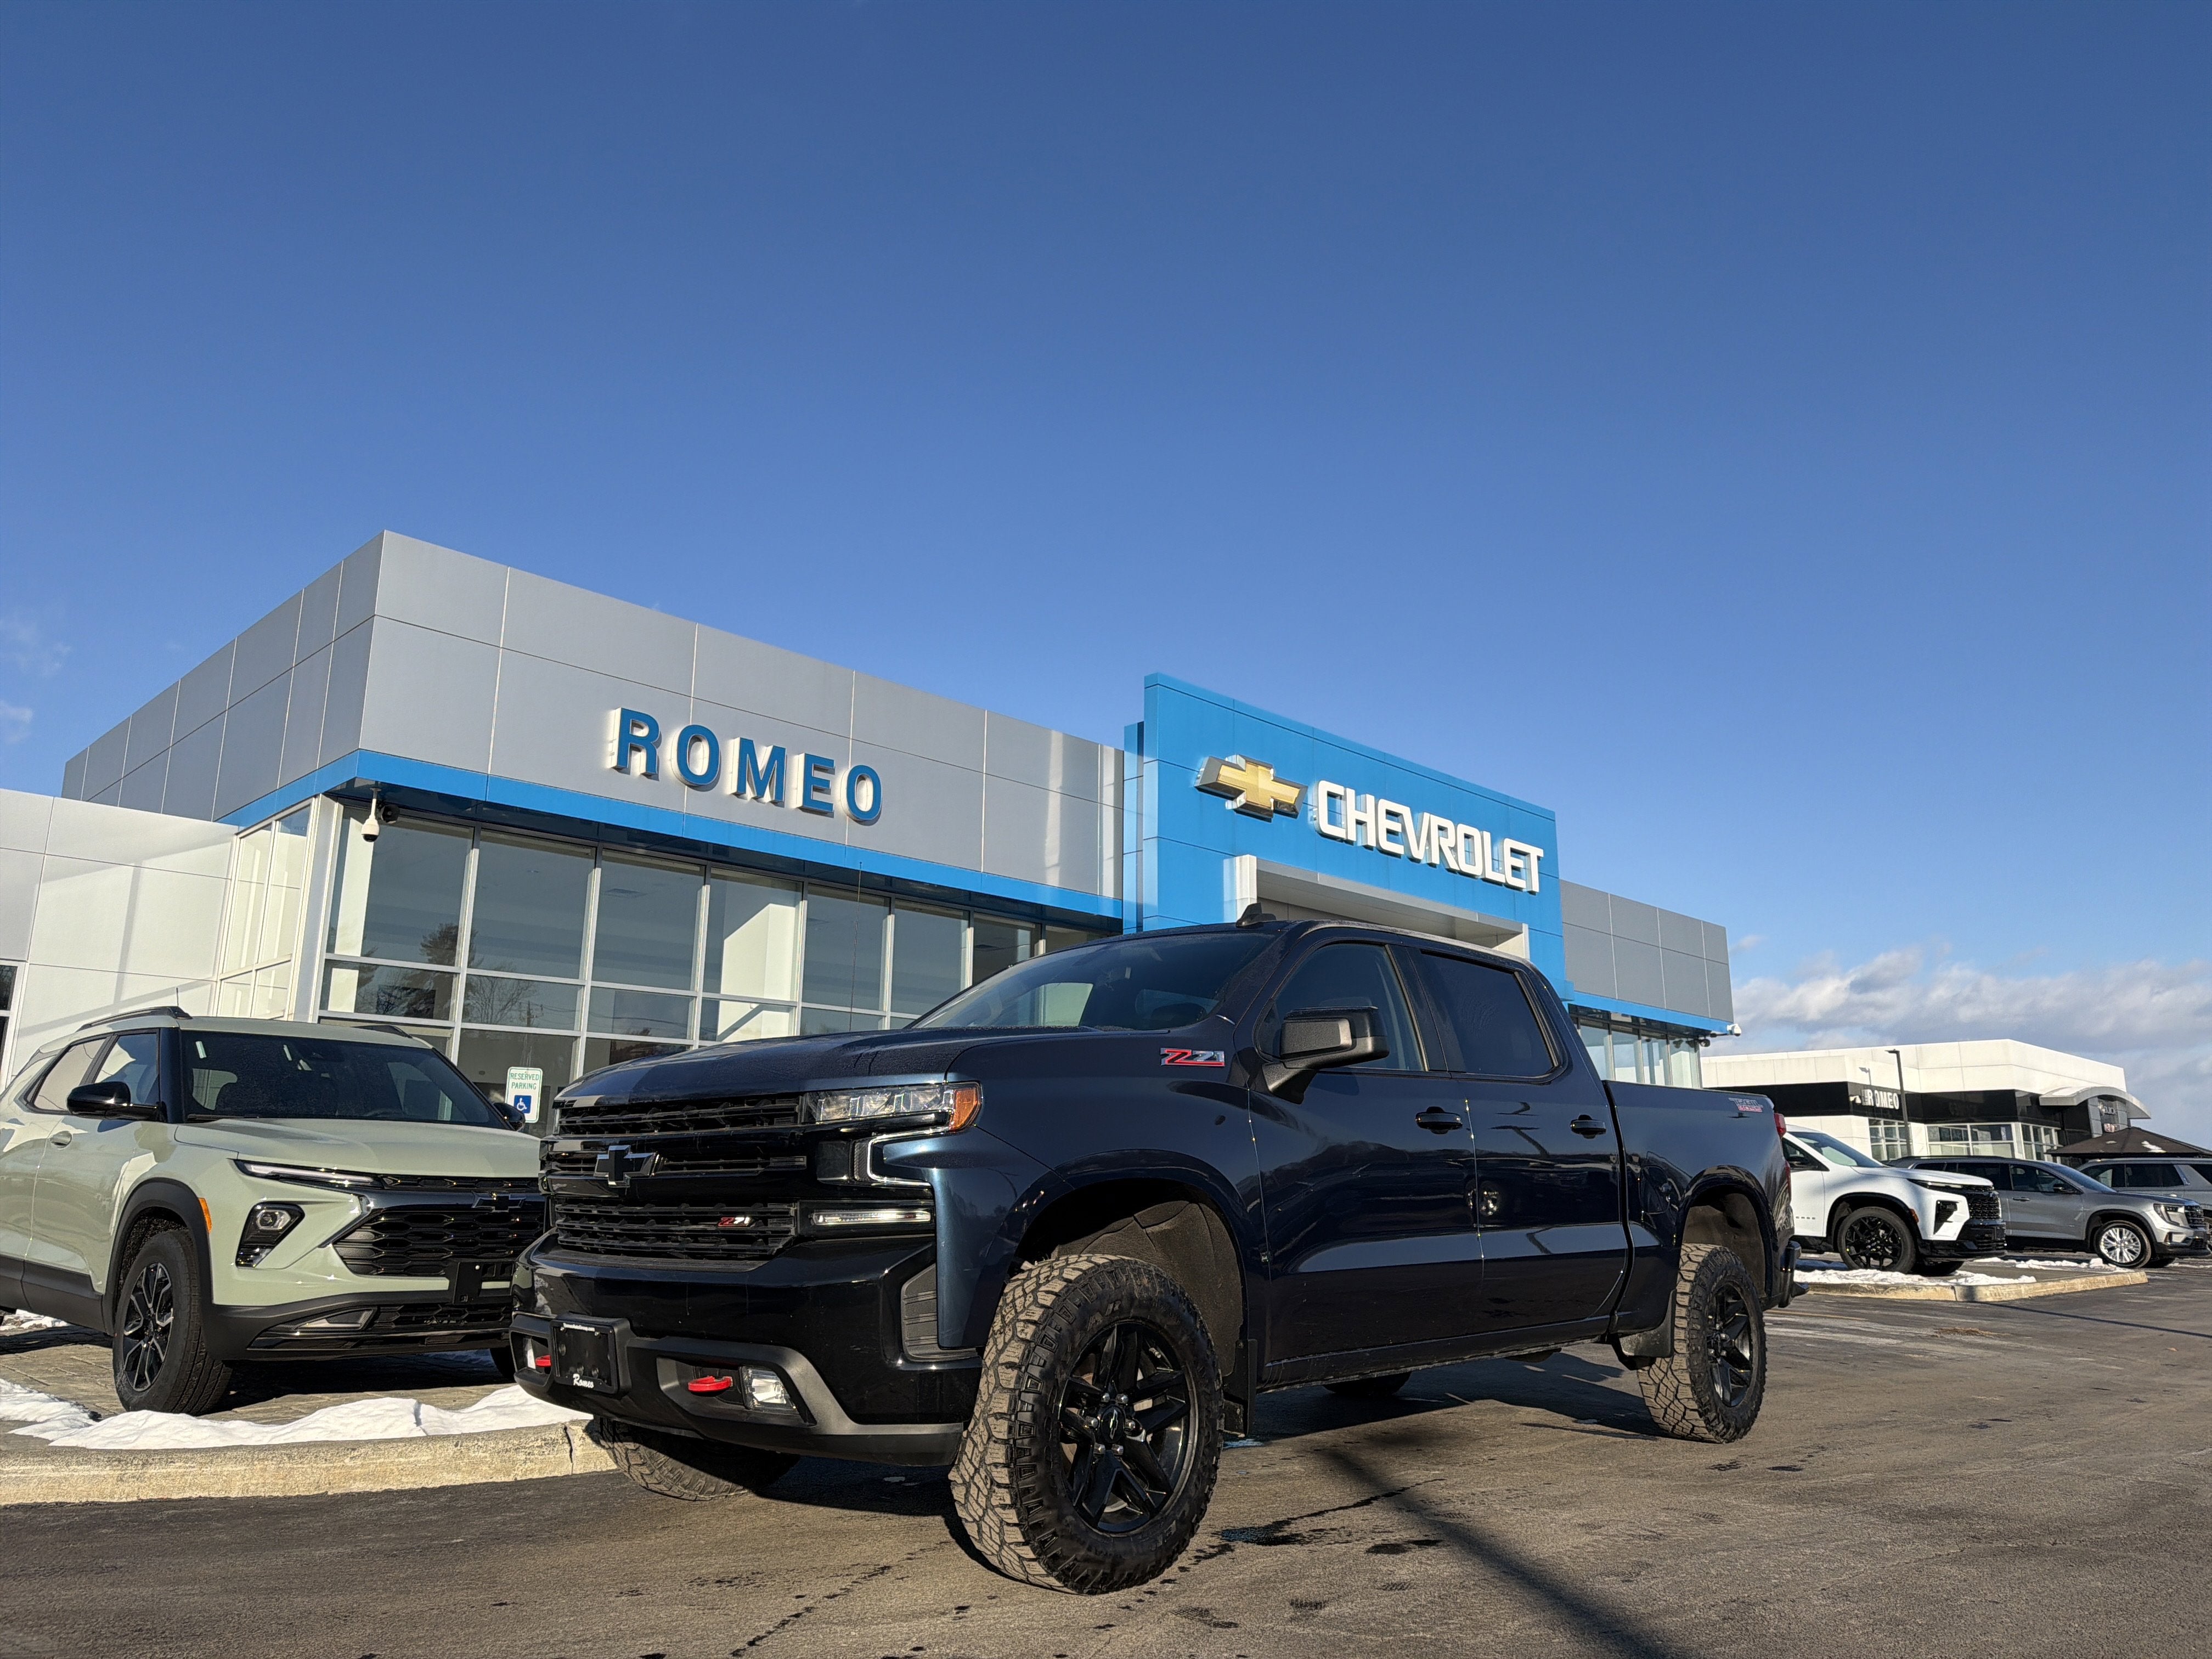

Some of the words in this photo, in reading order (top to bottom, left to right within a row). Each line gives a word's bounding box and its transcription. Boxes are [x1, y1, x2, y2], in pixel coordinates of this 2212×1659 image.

[612, 707, 883, 821] ROMEO
[1316, 780, 1544, 894] CHEVROLET
[1160, 1048, 1225, 1066] Z71
[510, 1073, 539, 1081] RESERVED
[511, 1081, 537, 1090] PARKING
[1865, 1089, 1899, 1110] ROMEO
[718, 1216, 751, 1227] Z71
[572, 1373, 595, 1389] Romeo
